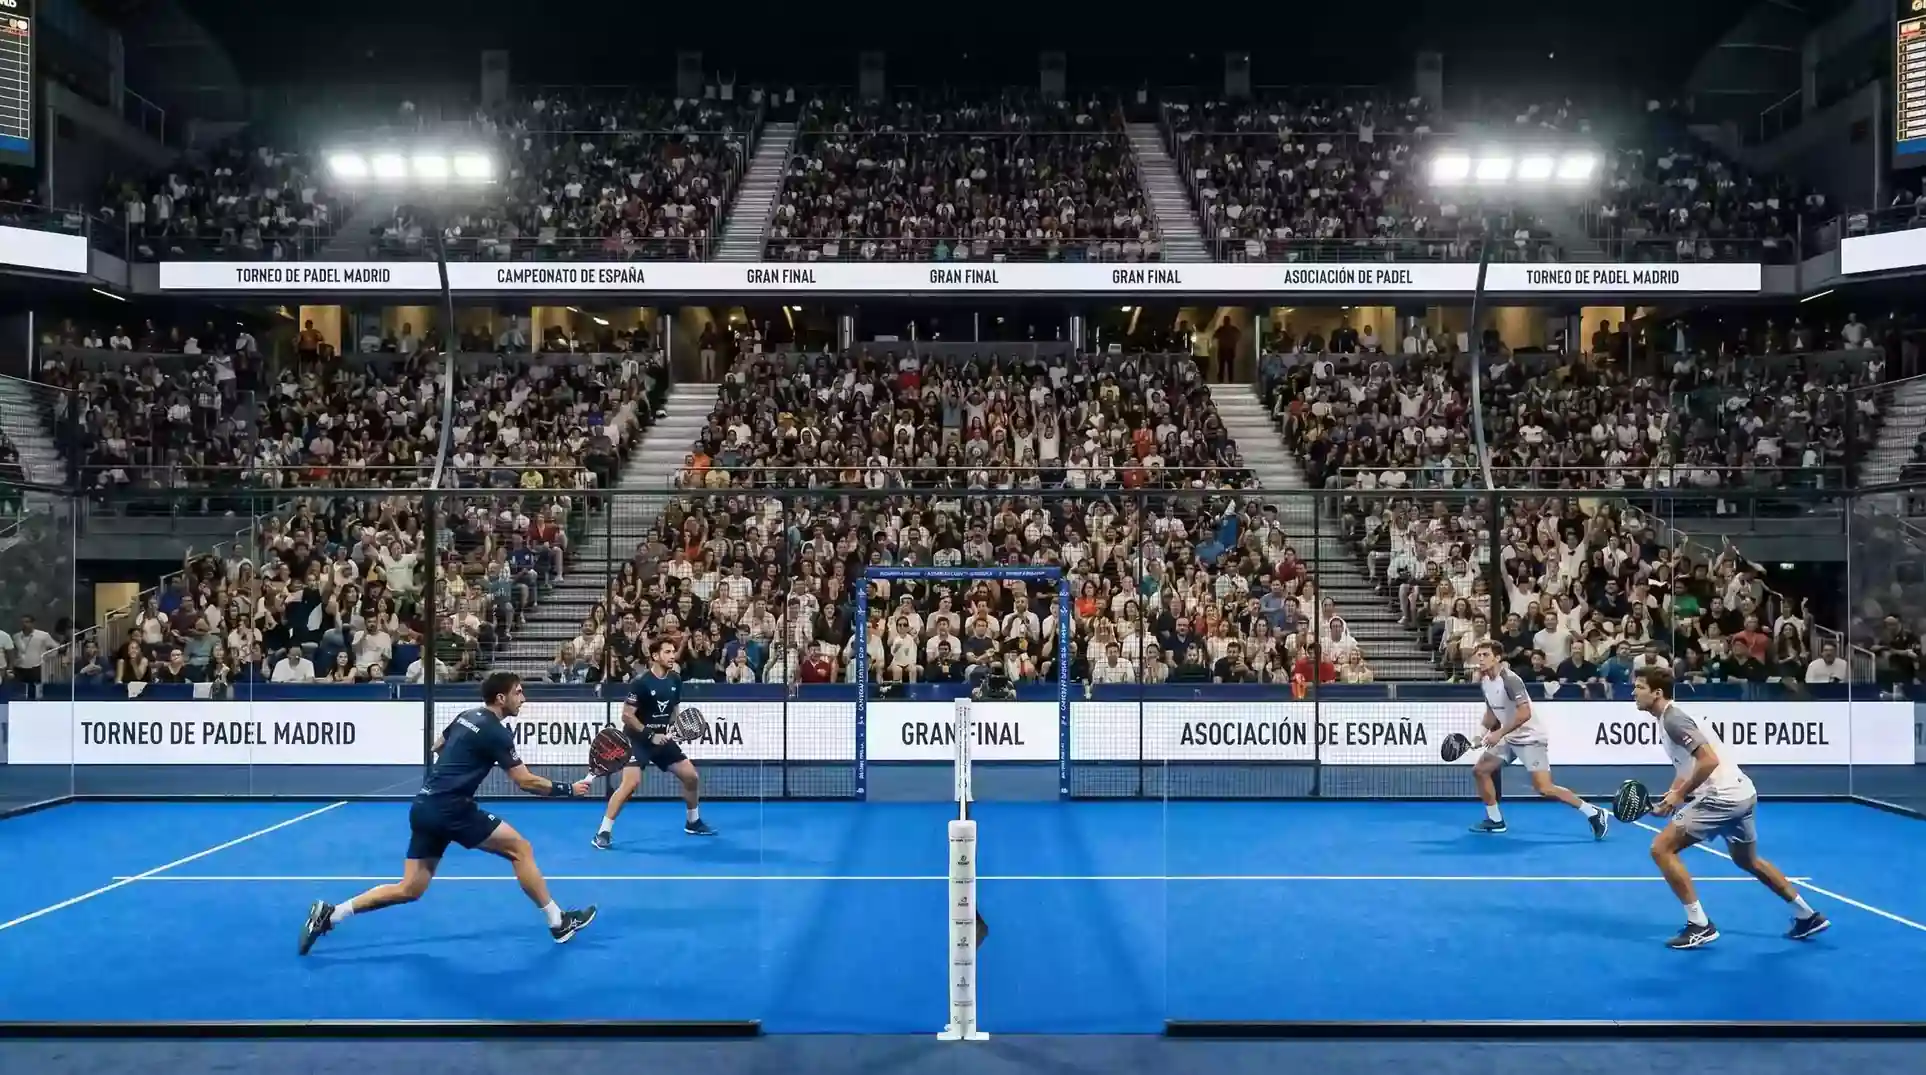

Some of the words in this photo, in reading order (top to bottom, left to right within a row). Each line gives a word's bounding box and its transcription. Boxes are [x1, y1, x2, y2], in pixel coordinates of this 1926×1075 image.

[235, 268, 282, 283] TORNEO
[285, 268, 301, 283] DE
[303, 268, 341, 283] PADEL
[343, 268, 391, 283] MADRID
[497, 268, 577, 284] CAMPEONATO
[580, 268, 596, 284] DE
[598, 266, 645, 284] ESPAÑA
[747, 268, 780, 284] GRAN
[782, 268, 817, 284] FINAL
[929, 268, 962, 284] GRAN
[965, 268, 999, 284] FINAL
[1112, 269, 1145, 284] GRAN
[1147, 269, 1182, 284] FINAL
[1283, 266, 1355, 284] ASOCIACIÓN
[1358, 269, 1373, 284] DE
[1376, 269, 1413, 284] PADEL
[1526, 269, 1572, 285] TORNEO
[1575, 269, 1591, 285] DE
[1593, 269, 1630, 285] PADEL
[1633, 269, 1680, 285] MADRID
[80, 721, 163, 745] TORNEO
[170, 721, 196, 745] DE
[202, 721, 267, 745] PADEL
[274, 721, 356, 745] MADRID
[505, 721, 617, 745] MPEONAT
[901, 721, 956, 745] GRAN
[1180, 716, 1307, 746] ASOCIACIÓN
[1315, 722, 1339, 746] DE
[1346, 716, 1428, 746] ESPAÑA
[1595, 716, 1725, 745] ASOCIN
[1732, 721, 1758, 746] DE
[1765, 721, 1829, 746] PADEL
